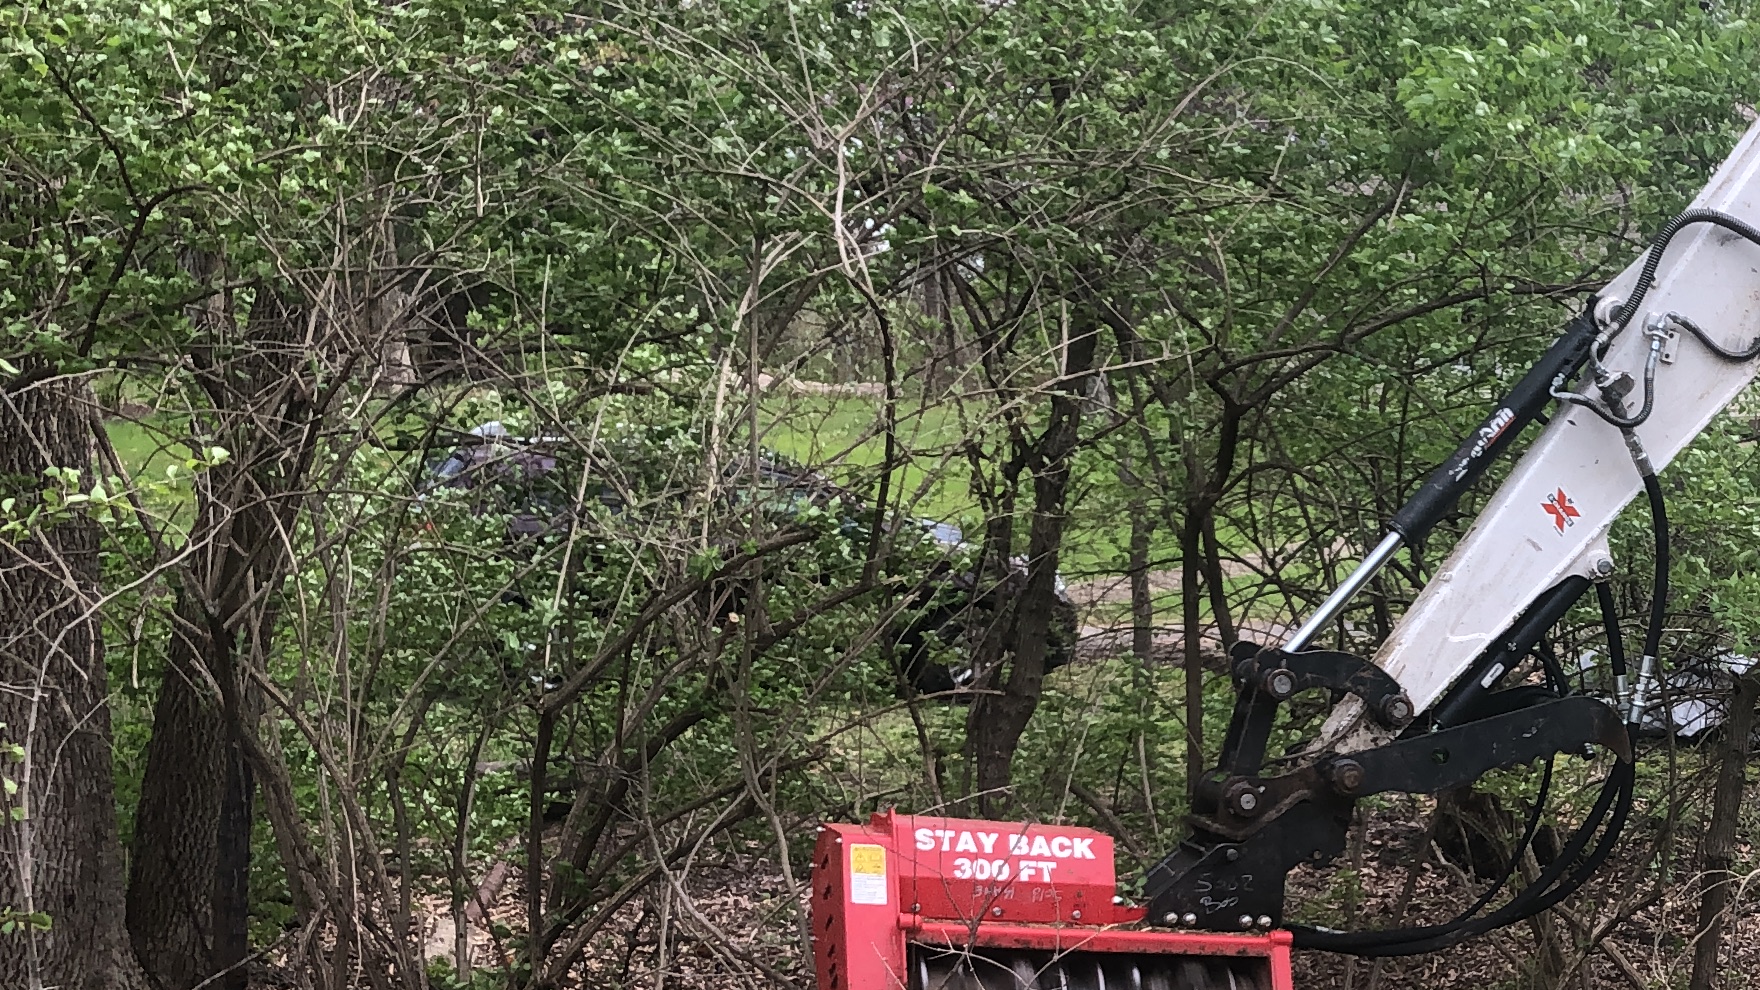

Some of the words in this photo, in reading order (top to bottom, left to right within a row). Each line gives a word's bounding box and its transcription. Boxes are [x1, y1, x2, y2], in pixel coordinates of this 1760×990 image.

[914, 828, 999, 854] STAY
[1008, 834, 1097, 860] BACK
[953, 857, 1010, 881] 300
[1019, 860, 1058, 882] FT
